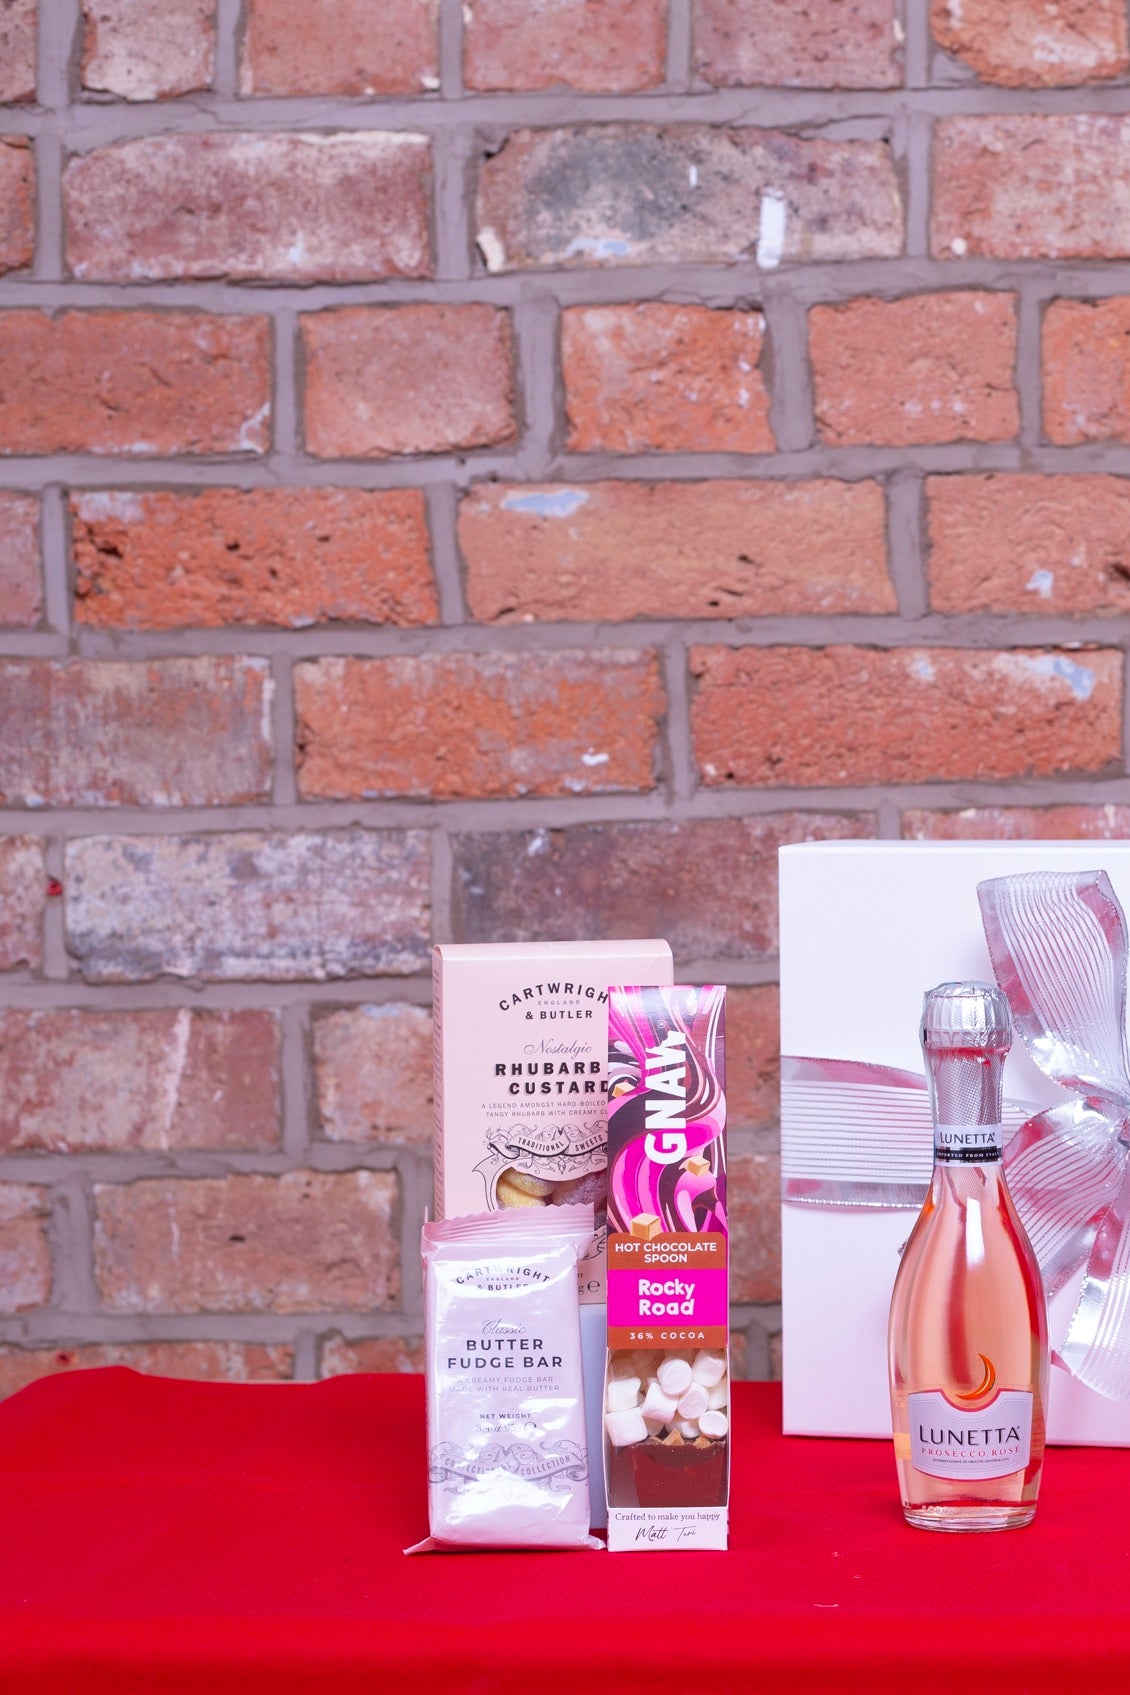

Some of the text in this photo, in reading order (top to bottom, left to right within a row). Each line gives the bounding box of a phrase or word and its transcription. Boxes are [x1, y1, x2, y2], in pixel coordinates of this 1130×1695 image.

[499, 982, 608, 1011] CARTWRIGH
[526, 1010, 593, 1020] & BUTLER
[524, 1038, 592, 1060] Nostalgic
[495, 1062, 600, 1075] RHUBARB
[644, 1030, 687, 1165] GNAW
[518, 1135, 603, 1151] TRADITIONAL SWEETS
[940, 1132, 994, 1144] LUNETTA
[615, 1242, 717, 1252] HOT CHOCOLATE
[644, 1254, 688, 1263] SPOON
[638, 1278, 696, 1299] Rocky
[639, 1299, 695, 1316] Road
[481, 1319, 527, 1335] Classic
[466, 1339, 543, 1351] BUTTER
[448, 1356, 562, 1369] FUDGE BAR
[920, 1424, 1019, 1445] LUNETTA
[921, 1448, 985, 1458] PROSECCO
[521, 1455, 571, 1475] COLLECTION
[615, 1513, 645, 1521] Crafted
[697, 1512, 721, 1521] happy
[635, 1525, 669, 1541] Matt
